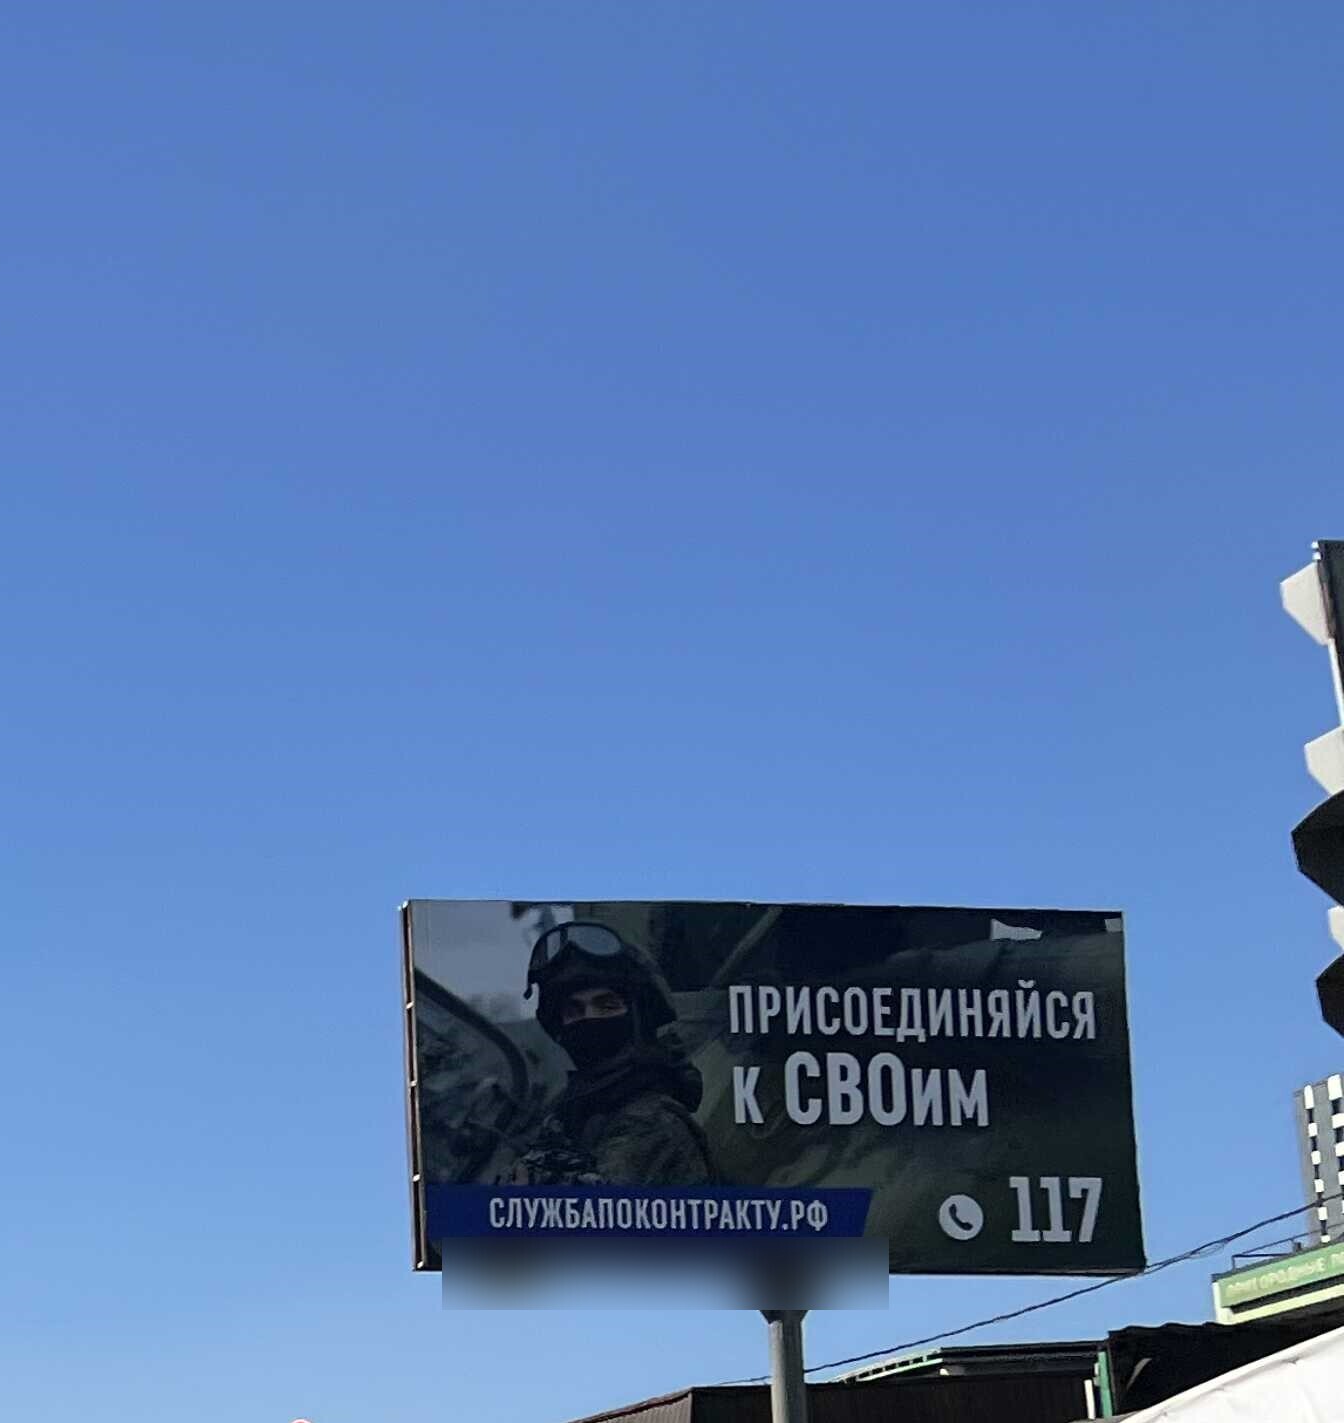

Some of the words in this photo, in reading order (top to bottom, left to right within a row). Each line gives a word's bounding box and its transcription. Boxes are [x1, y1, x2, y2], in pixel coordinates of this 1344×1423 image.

[728, 979, 1096, 1043] ПРИСОЕДИНЯЙСЯ
[489, 1198, 829, 1231] СЛУЖБАПОКОНТРАКТУ.РФ
[1009, 1176, 1103, 1243] 117
